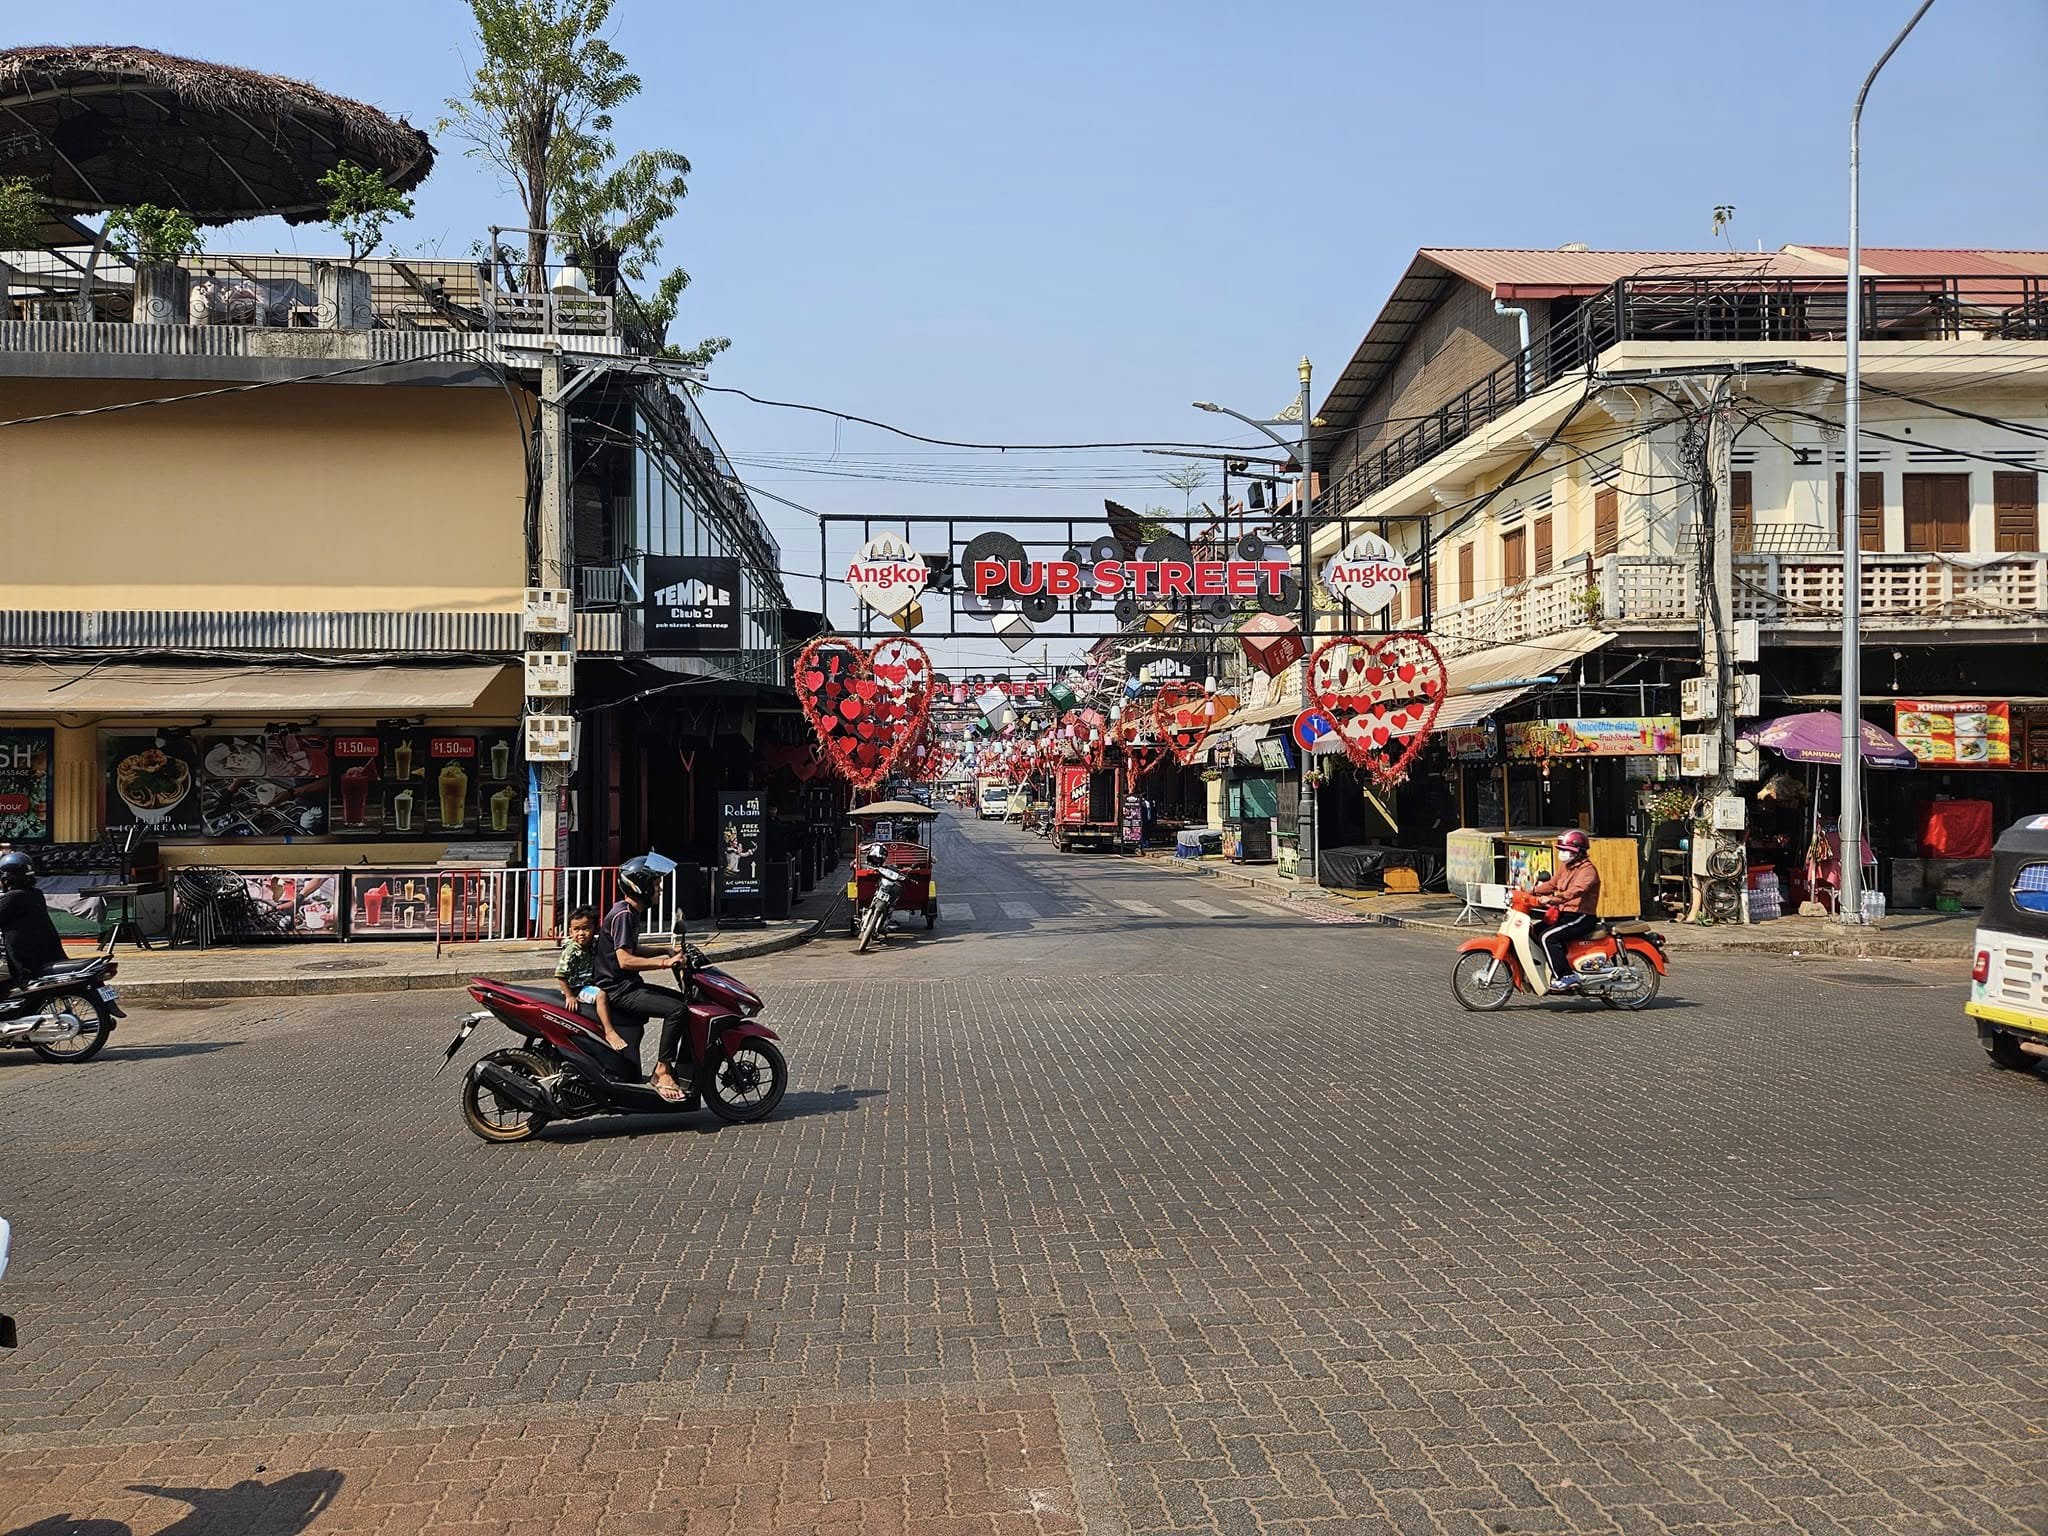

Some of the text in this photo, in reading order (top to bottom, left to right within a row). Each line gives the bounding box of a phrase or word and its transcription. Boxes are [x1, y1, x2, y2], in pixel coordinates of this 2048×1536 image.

[846, 563, 930, 587] Angkor
[974, 560, 1291, 596] PUB STREET
[1330, 564, 1409, 588] Angkor
[654, 578, 731, 606] TEMPLE
[671, 608, 713, 618] Club 3
[1147, 657, 1191, 677] EMPLE
[1917, 703, 1989, 712] KHMER FOOD
[1577, 720, 1615, 732] Smoothie
[338, 742, 363, 753] $1.50
[434, 742, 459, 753] $1.50
[725, 804, 760, 816] Robam
